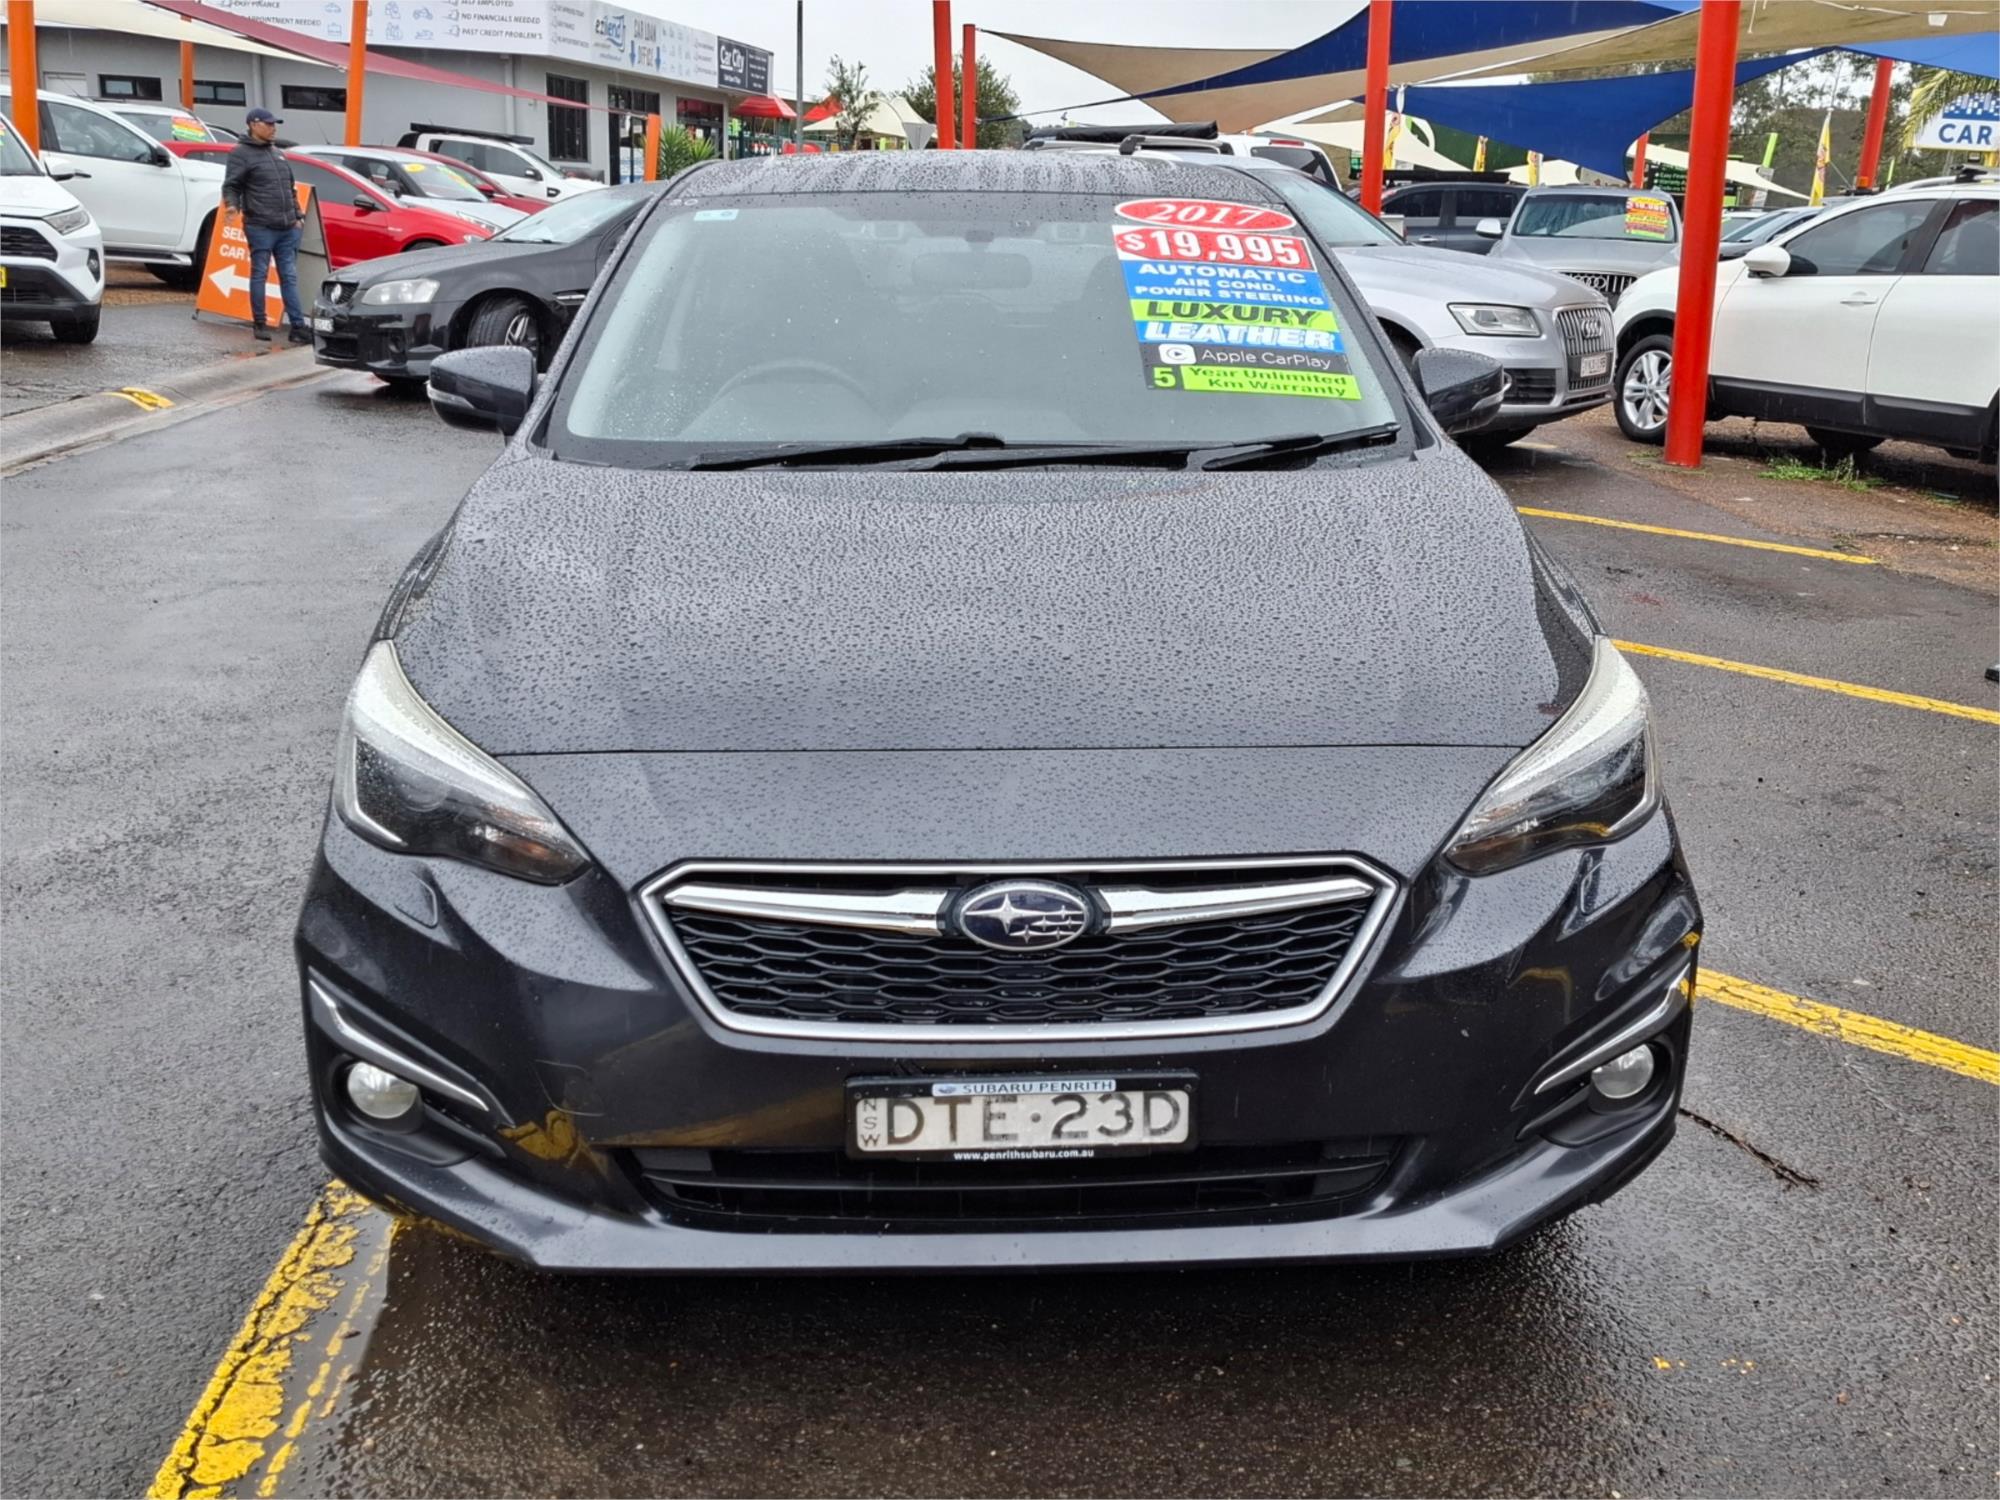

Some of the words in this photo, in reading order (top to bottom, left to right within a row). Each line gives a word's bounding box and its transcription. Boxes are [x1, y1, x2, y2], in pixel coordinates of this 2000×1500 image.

[251, 1, 280, 9] FINANCE
[295, 18, 322, 26] NEEDED
[473, 13, 512, 23] FINANCIALS
[513, 16, 541, 24] NEEDED
[479, 29, 504, 37] CREDIT
[505, 31, 543, 40] PROBLEM'S
[720, 45, 732, 66] Car
[732, 48, 744, 73] City
[1938, 123, 1992, 145] CAR
[1147, 203, 1262, 226] 2017
[219, 244, 246, 261] CAR
[1123, 230, 1301, 266] $19,995
[1138, 263, 1306, 284] AUTOMATIC
[1174, 277, 1211, 288] AIR
[1216, 279, 1282, 292] COND.
[1135, 285, 1211, 298] POWER
[1217, 289, 1324, 306] STEERING
[1147, 301, 1322, 326] LUXURY
[1144, 322, 1335, 350] LEATHER
[1201, 349, 1256, 366] Apple
[1261, 352, 1331, 370] CarPlay
[1153, 368, 1176, 388] 5
[1189, 367, 1239, 381] Year
[1243, 369, 1347, 385] Unlimited
[1208, 379, 1245, 390] Km
[1248, 380, 1346, 397] Warranty
[962, 1083, 1034, 1094] SUBARU
[1038, 1080, 1113, 1093] PENRITH
[953, 1148, 1095, 1162] www.penrithsubaru.com.au
